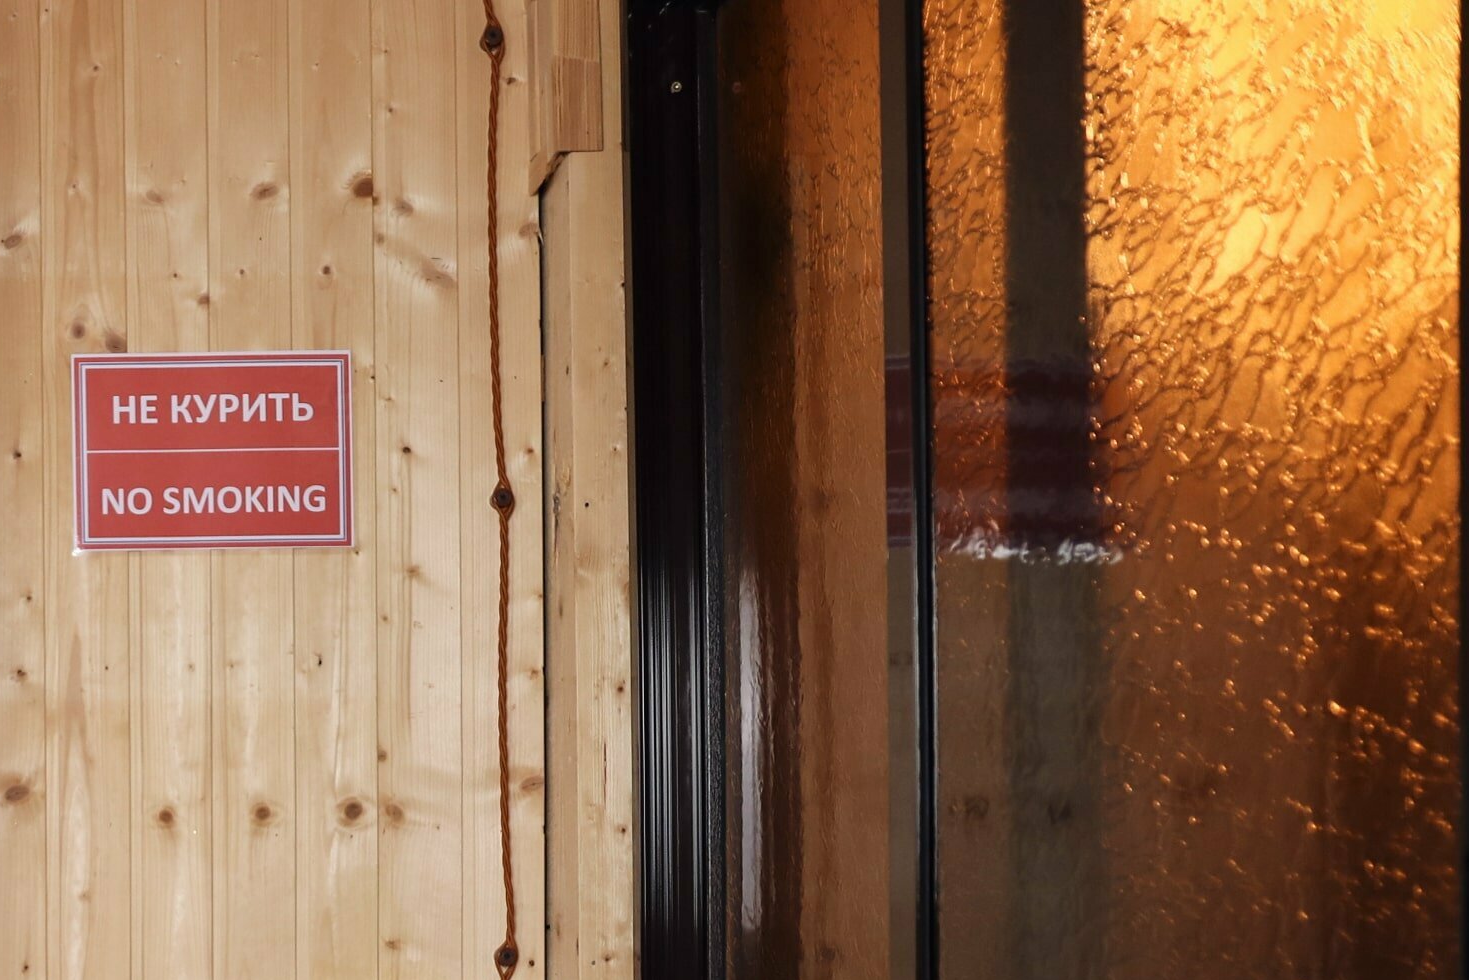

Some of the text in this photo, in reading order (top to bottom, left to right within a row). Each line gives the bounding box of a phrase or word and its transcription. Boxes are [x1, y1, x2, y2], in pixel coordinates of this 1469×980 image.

[112, 392, 314, 424] НЕ КУРИТЬ
[101, 484, 327, 515] NO SMOKING
